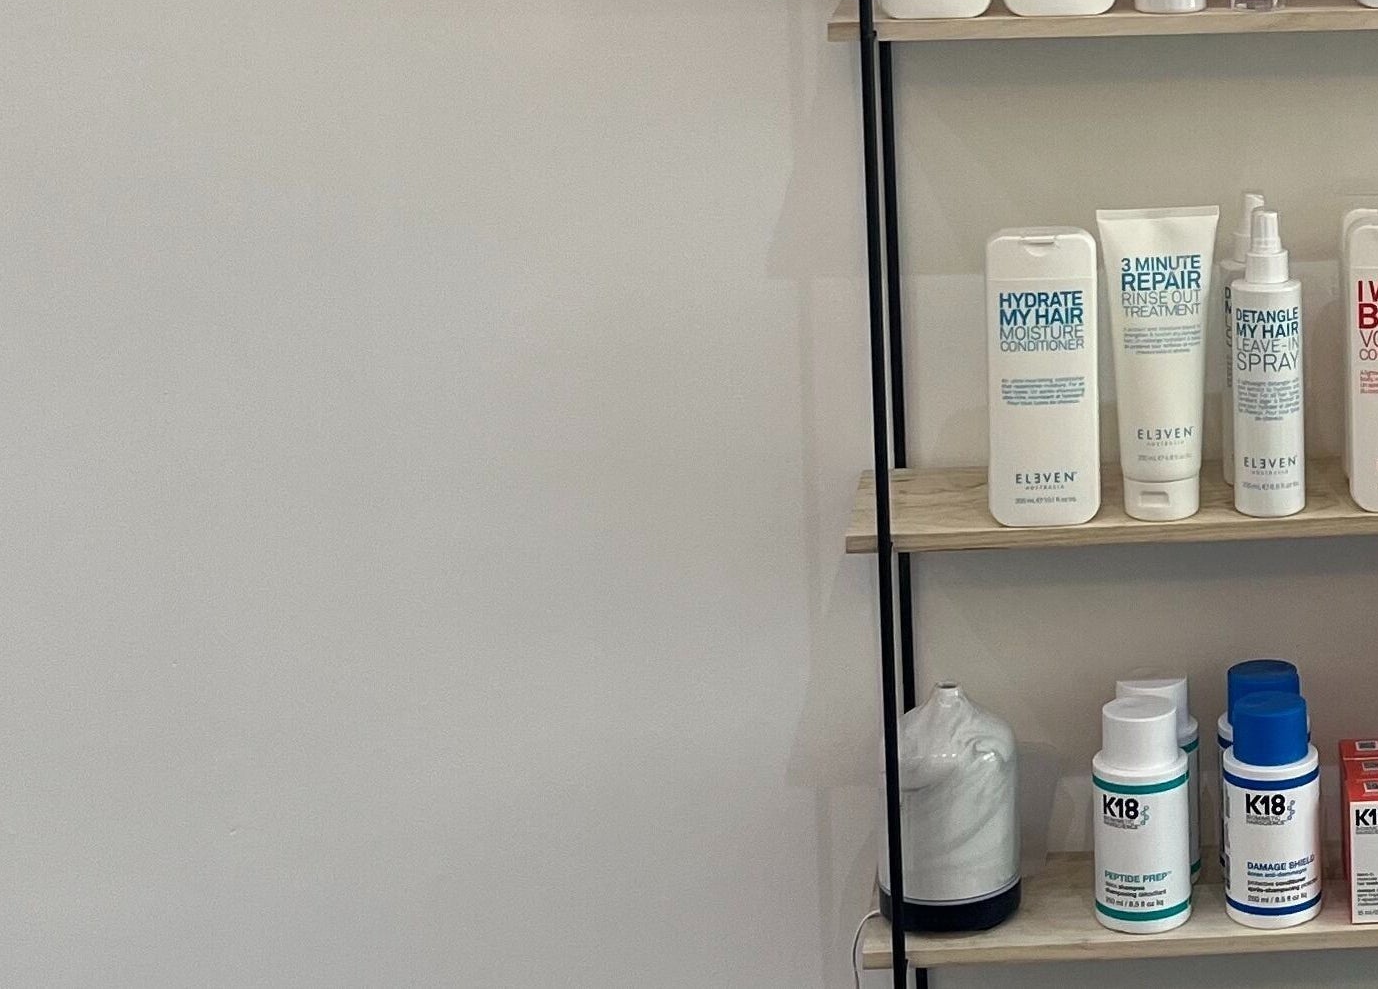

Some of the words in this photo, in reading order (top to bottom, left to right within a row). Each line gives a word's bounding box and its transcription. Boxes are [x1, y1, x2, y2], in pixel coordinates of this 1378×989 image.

[1121, 258, 1130, 272] 3
[1135, 255, 1201, 271] MINUTE
[1121, 271, 1201, 291] REPAIR
[1000, 291, 1083, 308] HYDRATE
[1122, 291, 1167, 305] RINSE
[1172, 290, 1200, 304] OUT
[1358, 280, 1363, 302] I
[1000, 309, 1034, 326] MY
[1035, 308, 1083, 325] HAIR
[1123, 303, 1201, 318] TREATMENT
[1235, 307, 1299, 323] DETANGLE
[1000, 324, 1084, 341] MOISTURE
[1236, 324, 1258, 339] MY
[1262, 322, 1299, 339] HAIR
[1001, 339, 1085, 352] CONDITIONER
[1236, 336, 1299, 353] LEAVE-IN
[1237, 354, 1299, 372] SPRAY
[1103, 794, 1139, 819] K18
[1246, 793, 1285, 815] K18
[1247, 861, 1287, 870] DAMAGE
[1289, 854, 1315, 869] SHIELD
[1105, 870, 1140, 883] PEPTIDE
